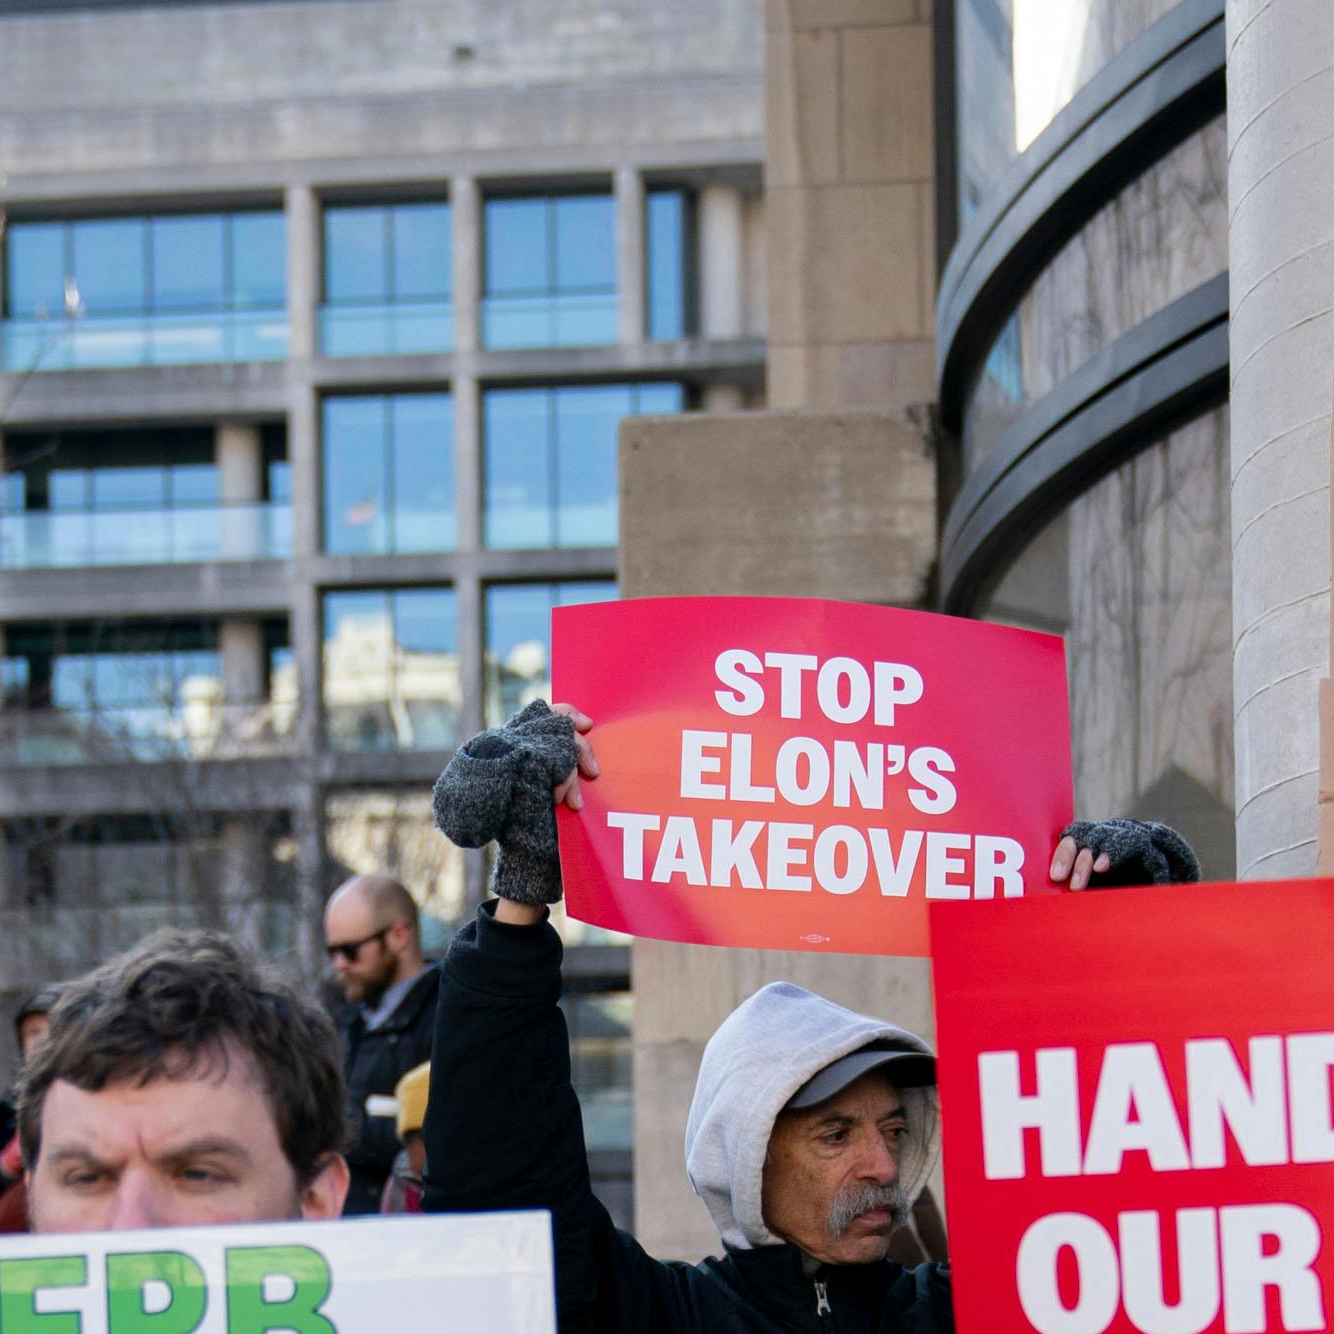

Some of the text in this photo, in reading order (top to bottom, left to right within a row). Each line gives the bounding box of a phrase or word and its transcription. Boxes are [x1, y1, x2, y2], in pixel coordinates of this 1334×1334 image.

[713, 648, 924, 727] STOP
[679, 728, 957, 815] ELON’S
[606, 810, 1025, 900] TAKEOVER
